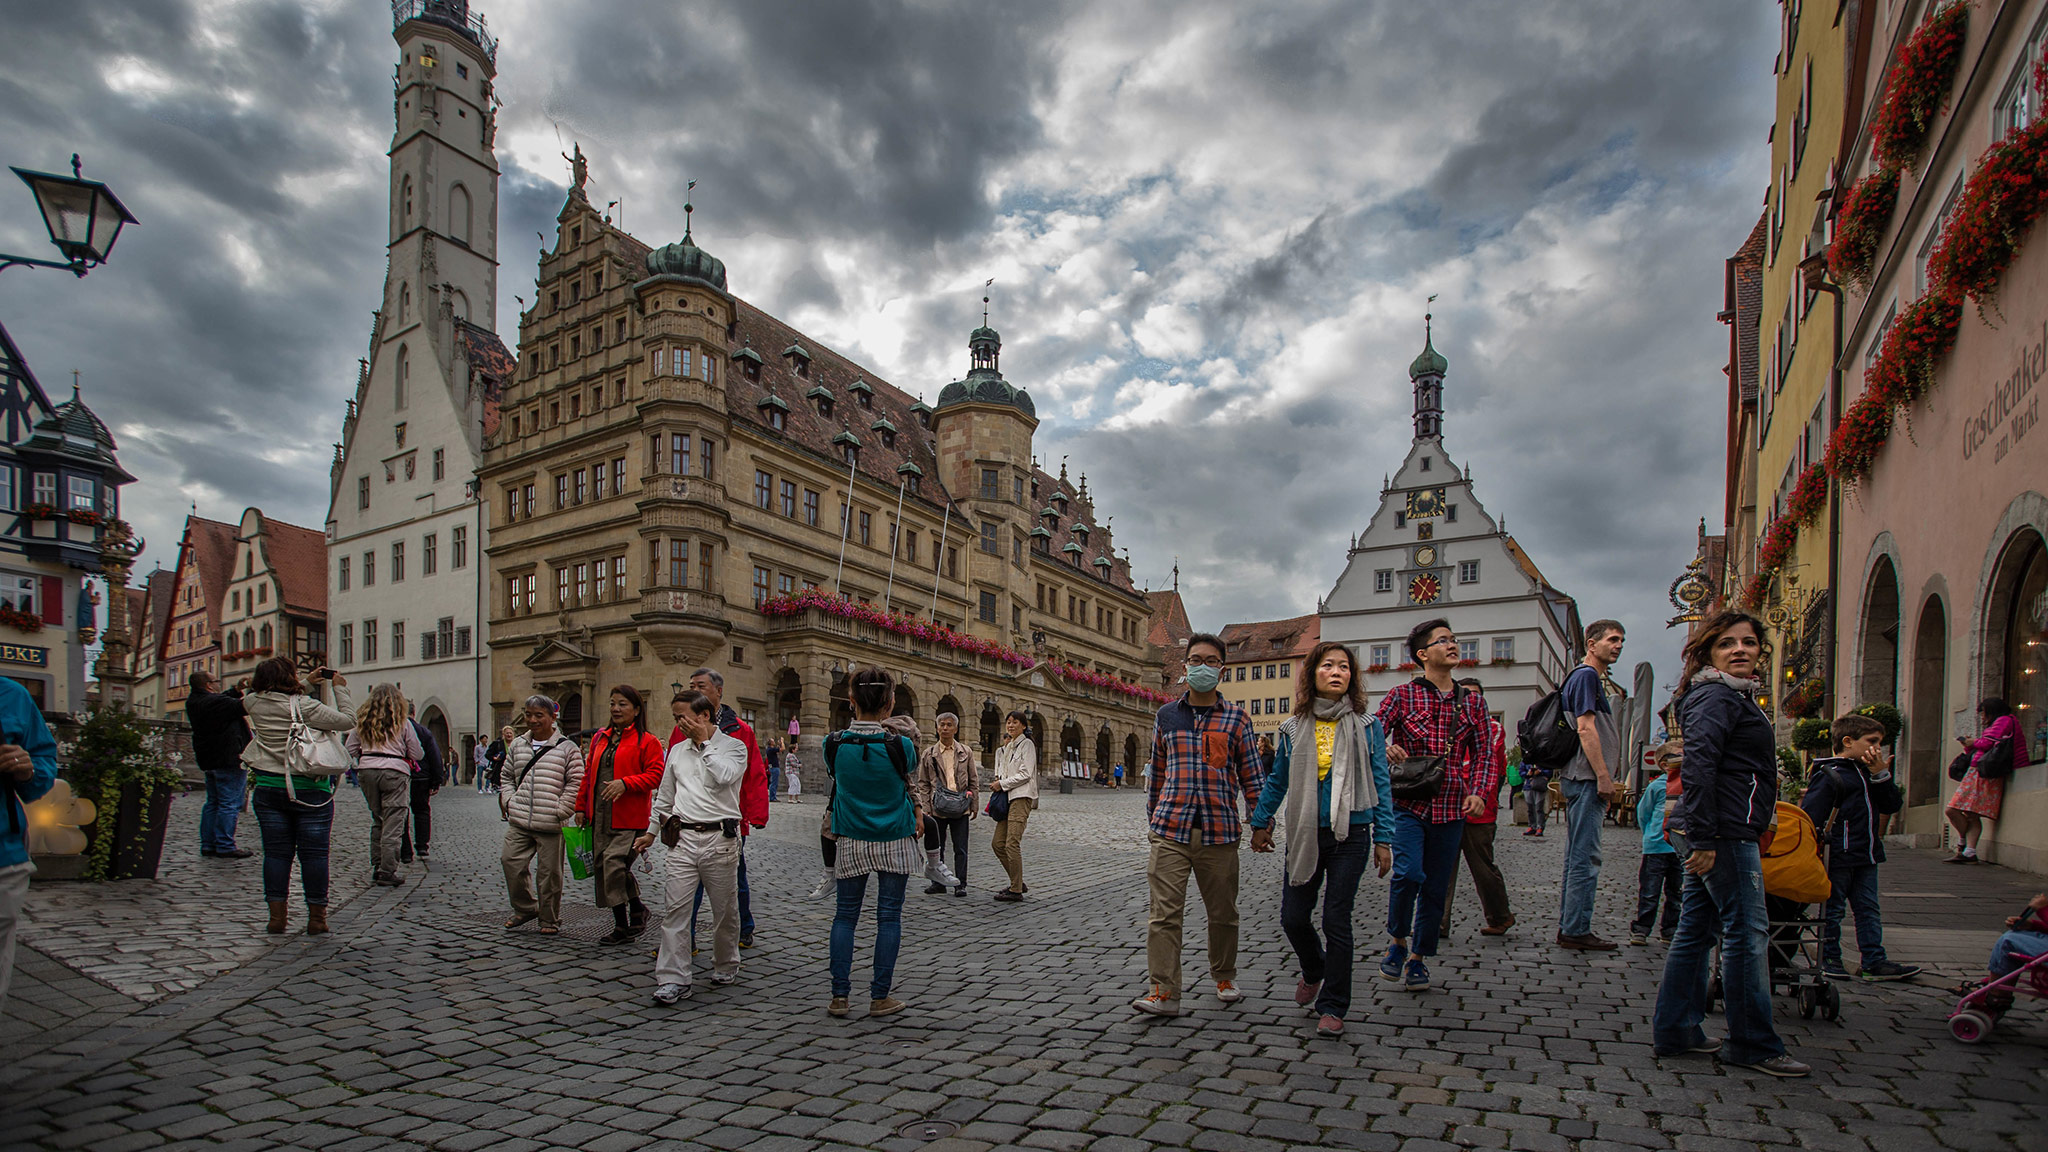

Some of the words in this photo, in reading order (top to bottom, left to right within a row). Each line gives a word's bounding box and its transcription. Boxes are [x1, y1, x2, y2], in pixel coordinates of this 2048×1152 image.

[1993, 432, 2009, 465] am
[2010, 392, 2039, 449] Markt
[0, 645, 41, 663] EKE
